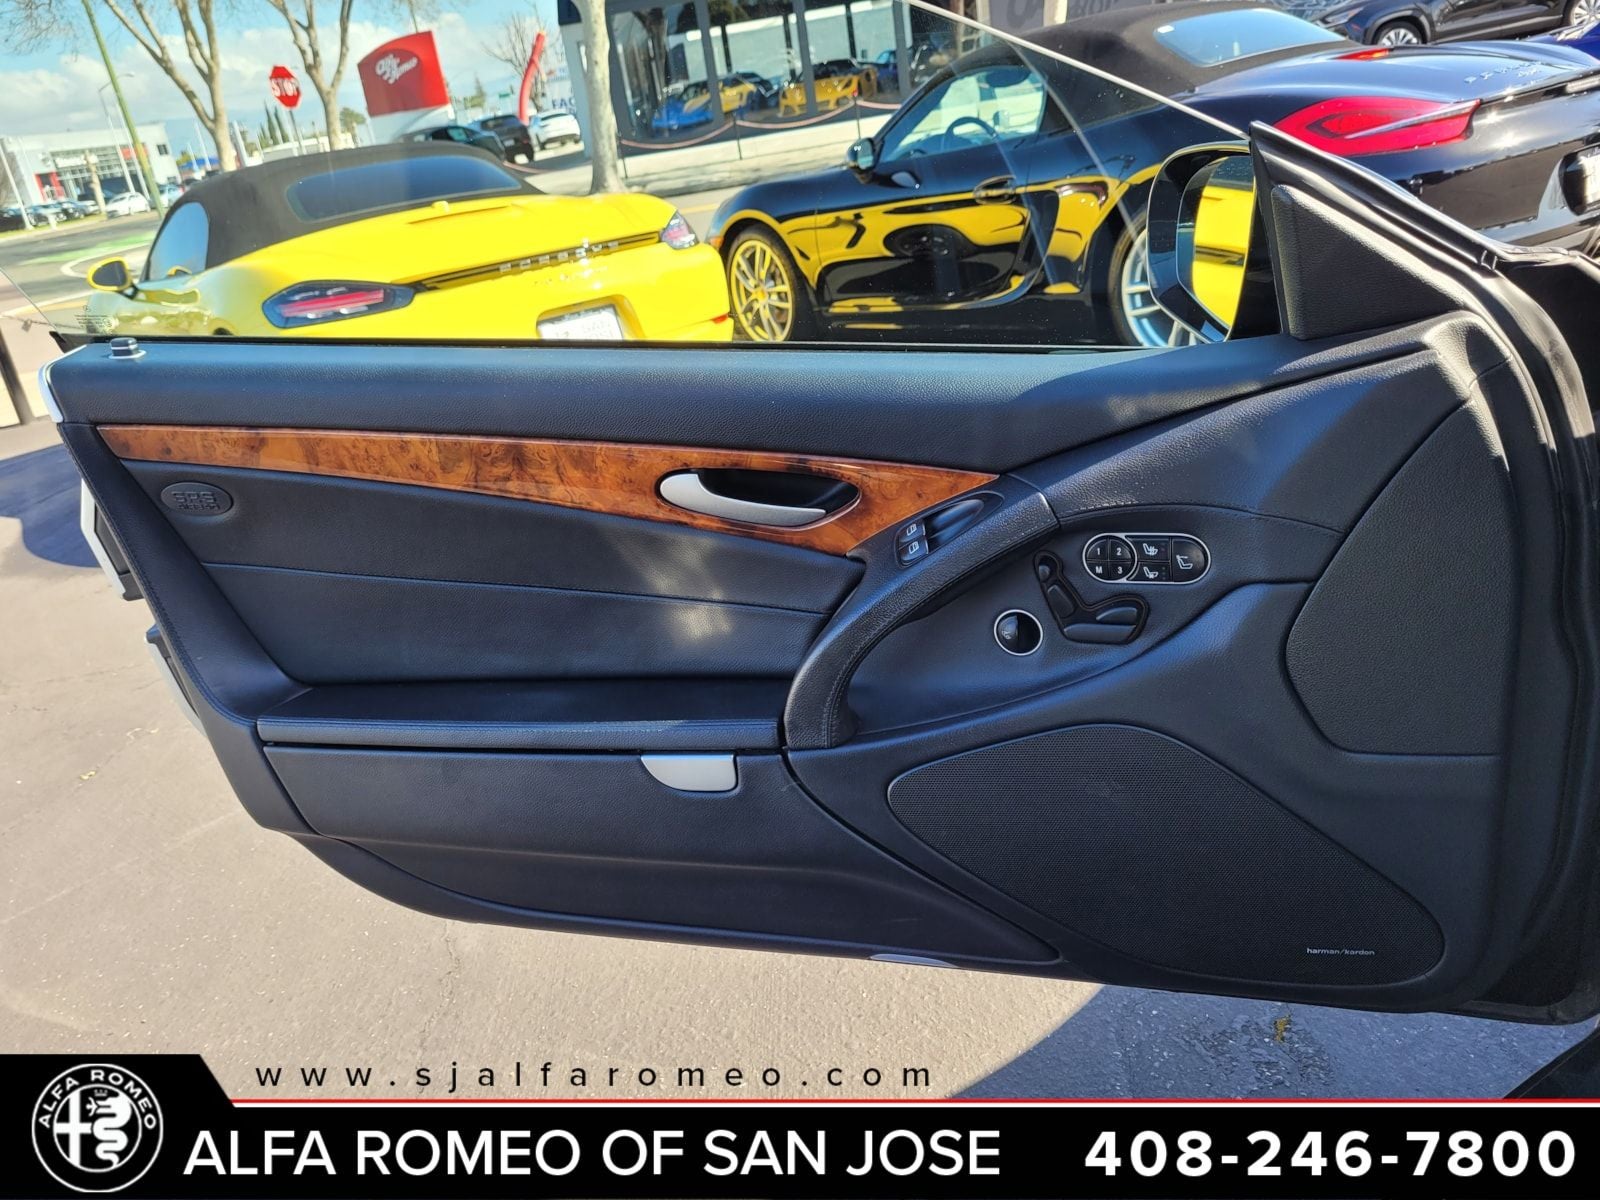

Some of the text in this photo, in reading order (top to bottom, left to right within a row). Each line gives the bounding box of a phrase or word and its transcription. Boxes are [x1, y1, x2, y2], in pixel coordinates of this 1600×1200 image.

[1116, 547, 1122, 556] 2
[1095, 565, 1103, 574] M
[1117, 566, 1123, 575] 3
